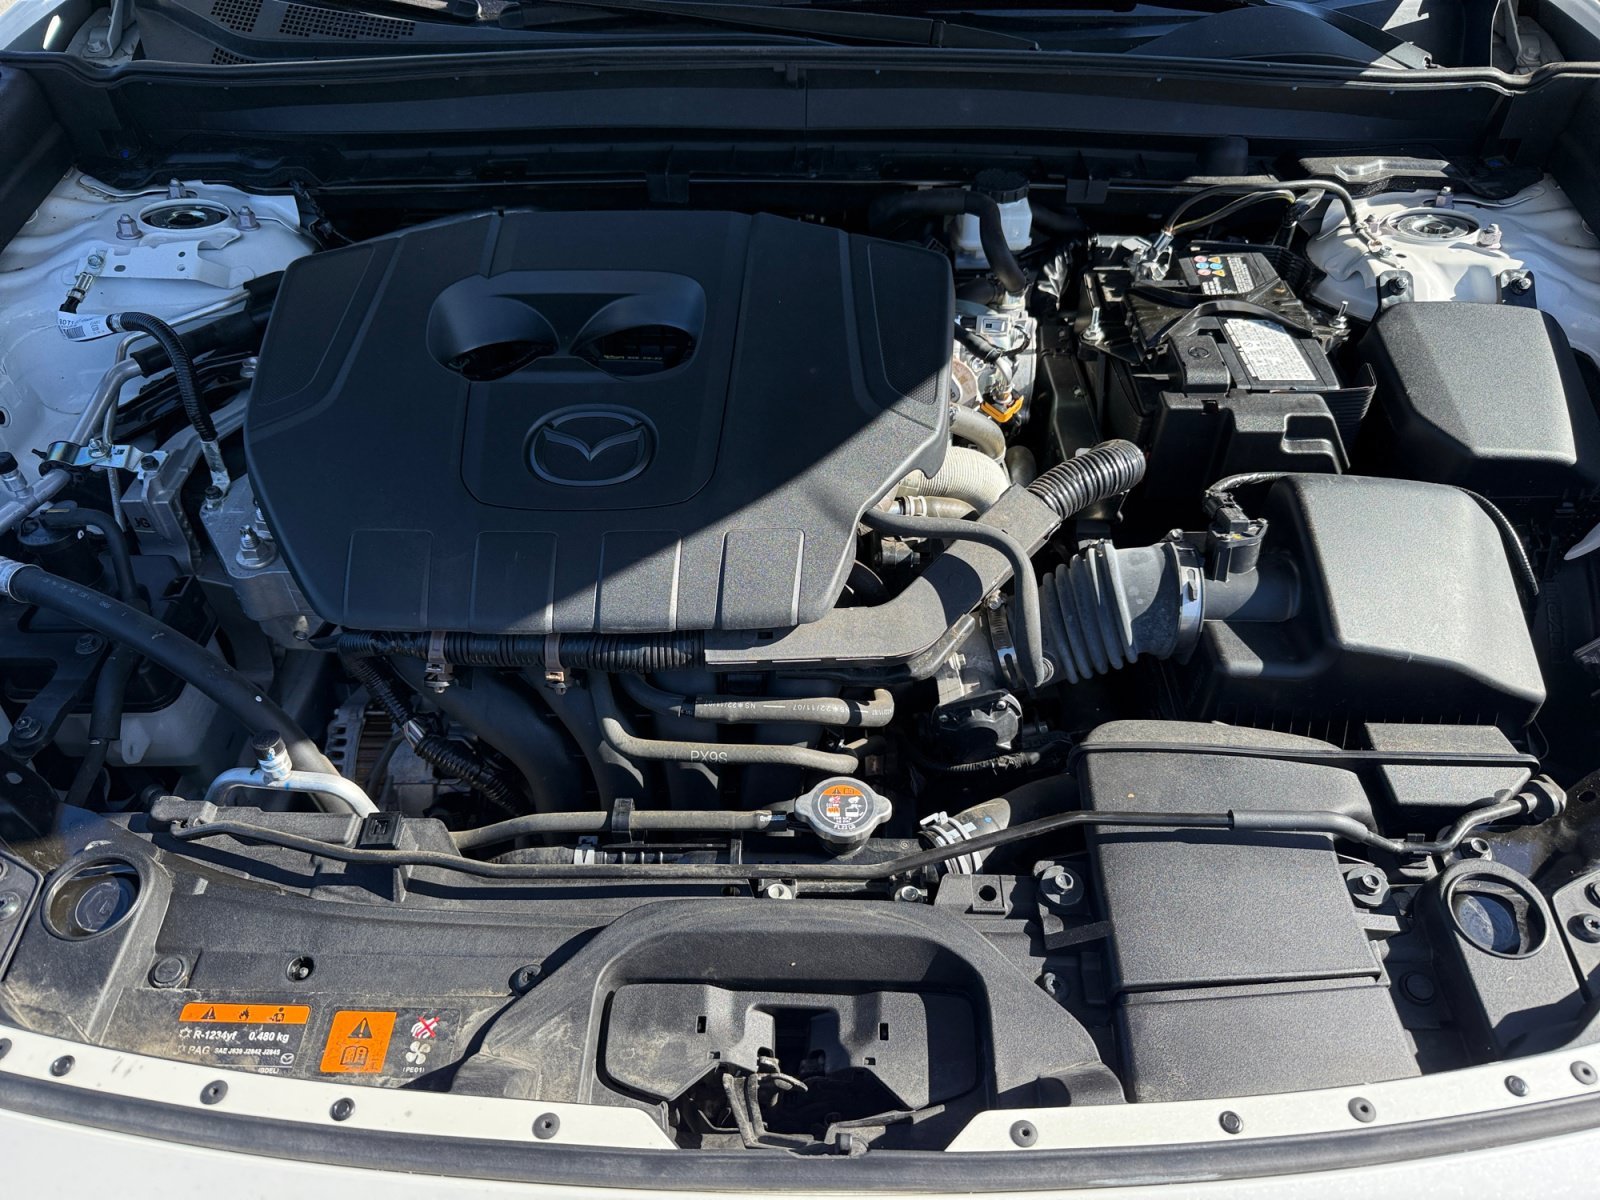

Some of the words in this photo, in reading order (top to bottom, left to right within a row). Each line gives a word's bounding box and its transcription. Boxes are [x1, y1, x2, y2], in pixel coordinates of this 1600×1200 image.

[690, 750, 728, 763] PX9S
[193, 1030, 238, 1042] R-1234yf
[248, 1031, 275, 1041] 0.480
[276, 1032, 290, 1043] kg
[187, 1045, 210, 1055] PAG
